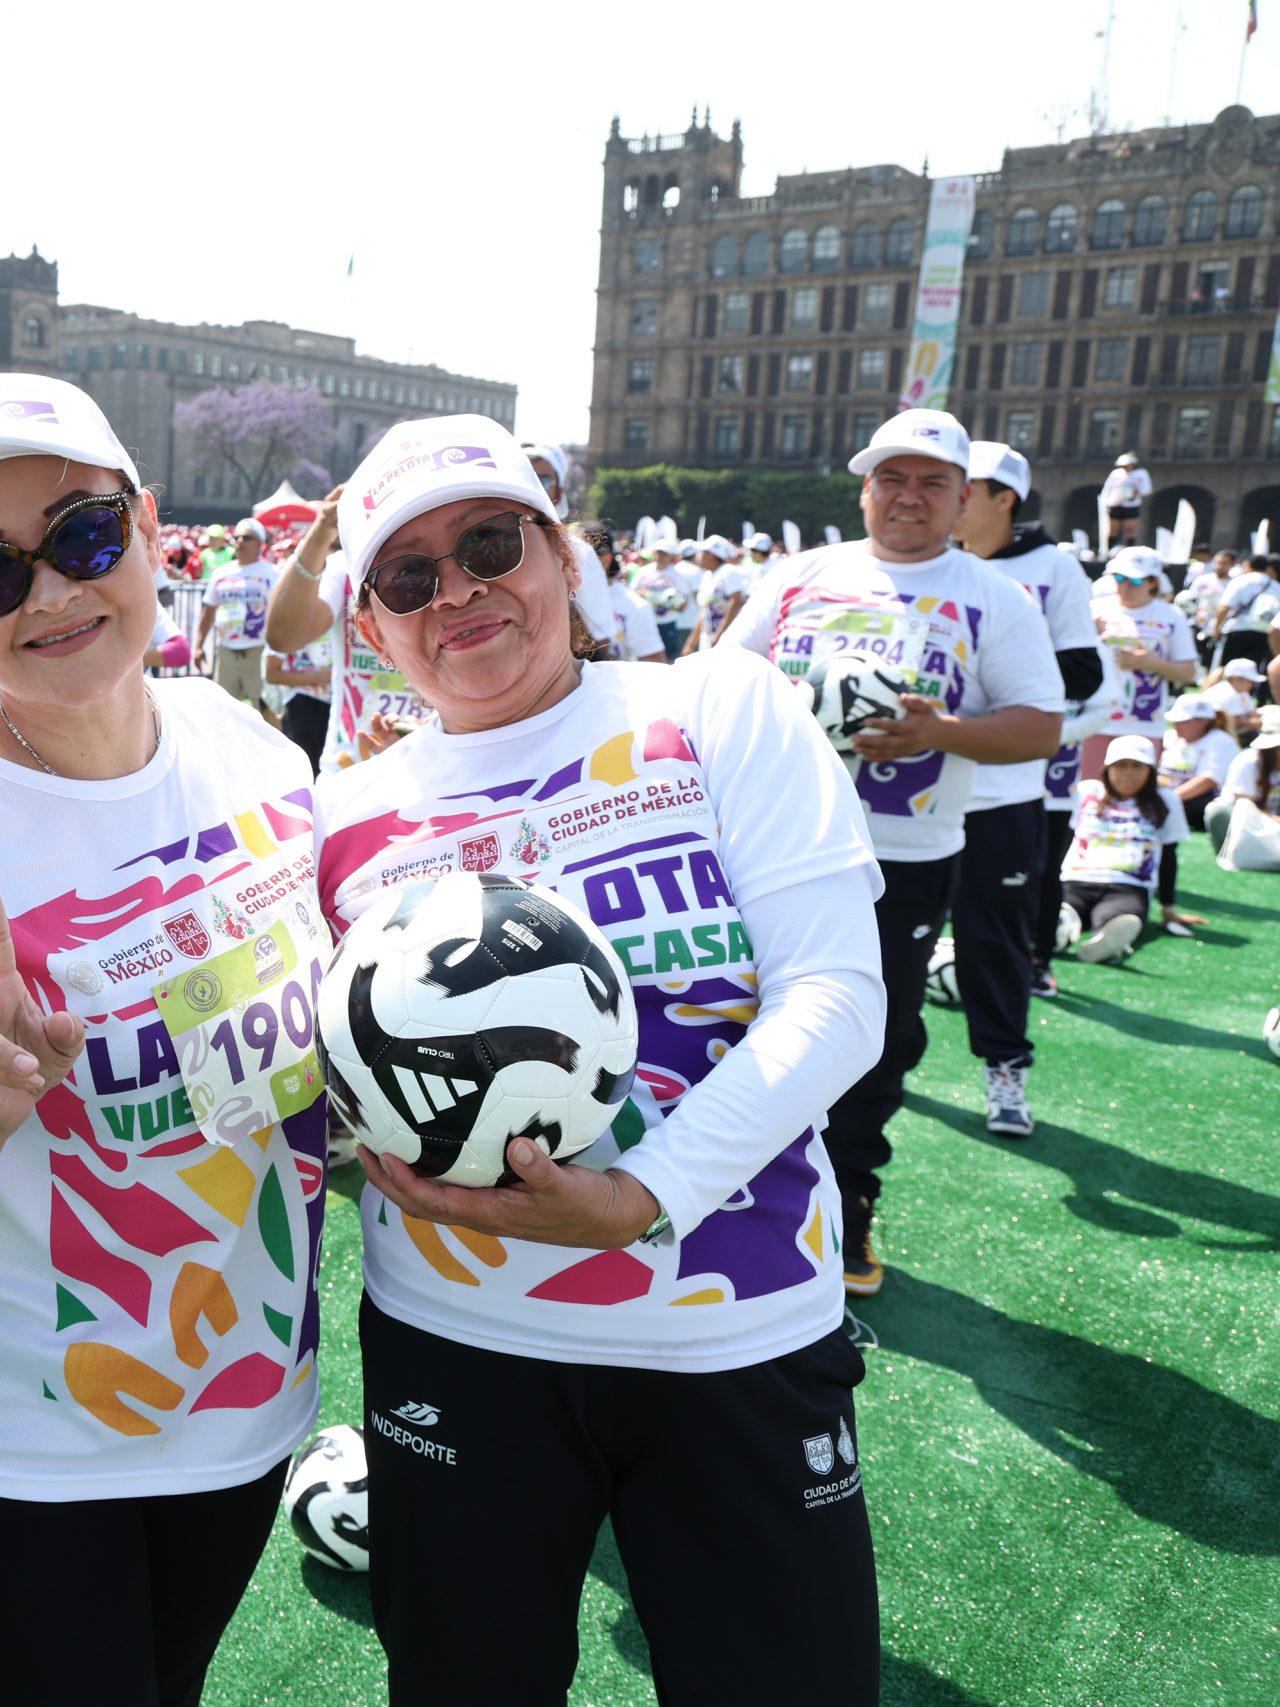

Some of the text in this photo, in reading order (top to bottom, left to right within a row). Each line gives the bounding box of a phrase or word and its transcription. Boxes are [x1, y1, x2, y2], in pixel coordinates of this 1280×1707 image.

[386, 454, 431, 483] PELOTA
[782, 634, 814, 655] LA
[548, 776, 700, 829] GOBIERNO DE LA
[551, 790, 705, 842] CIUDAD DE MÉXICO
[554, 806, 710, 854] CAPITAL DE LA TRANSFORMACIÓN
[292, 854, 312, 870] DE
[381, 852, 455, 879] Gobierno de
[245, 887, 287, 915] CIUDAD
[98, 938, 155, 969] Gobierno
[614, 921, 753, 976] CASA
[103, 948, 174, 985] México
[85, 1020, 181, 1096] LA
[417, 1046, 456, 1060] TIRO CLUB
[371, 1410, 457, 1465] INDEPORTE
[804, 1483, 838, 1499] CIUDAD
[839, 1478, 849, 1489] DE
[805, 1493, 841, 1509] CAPITAL DE LA
